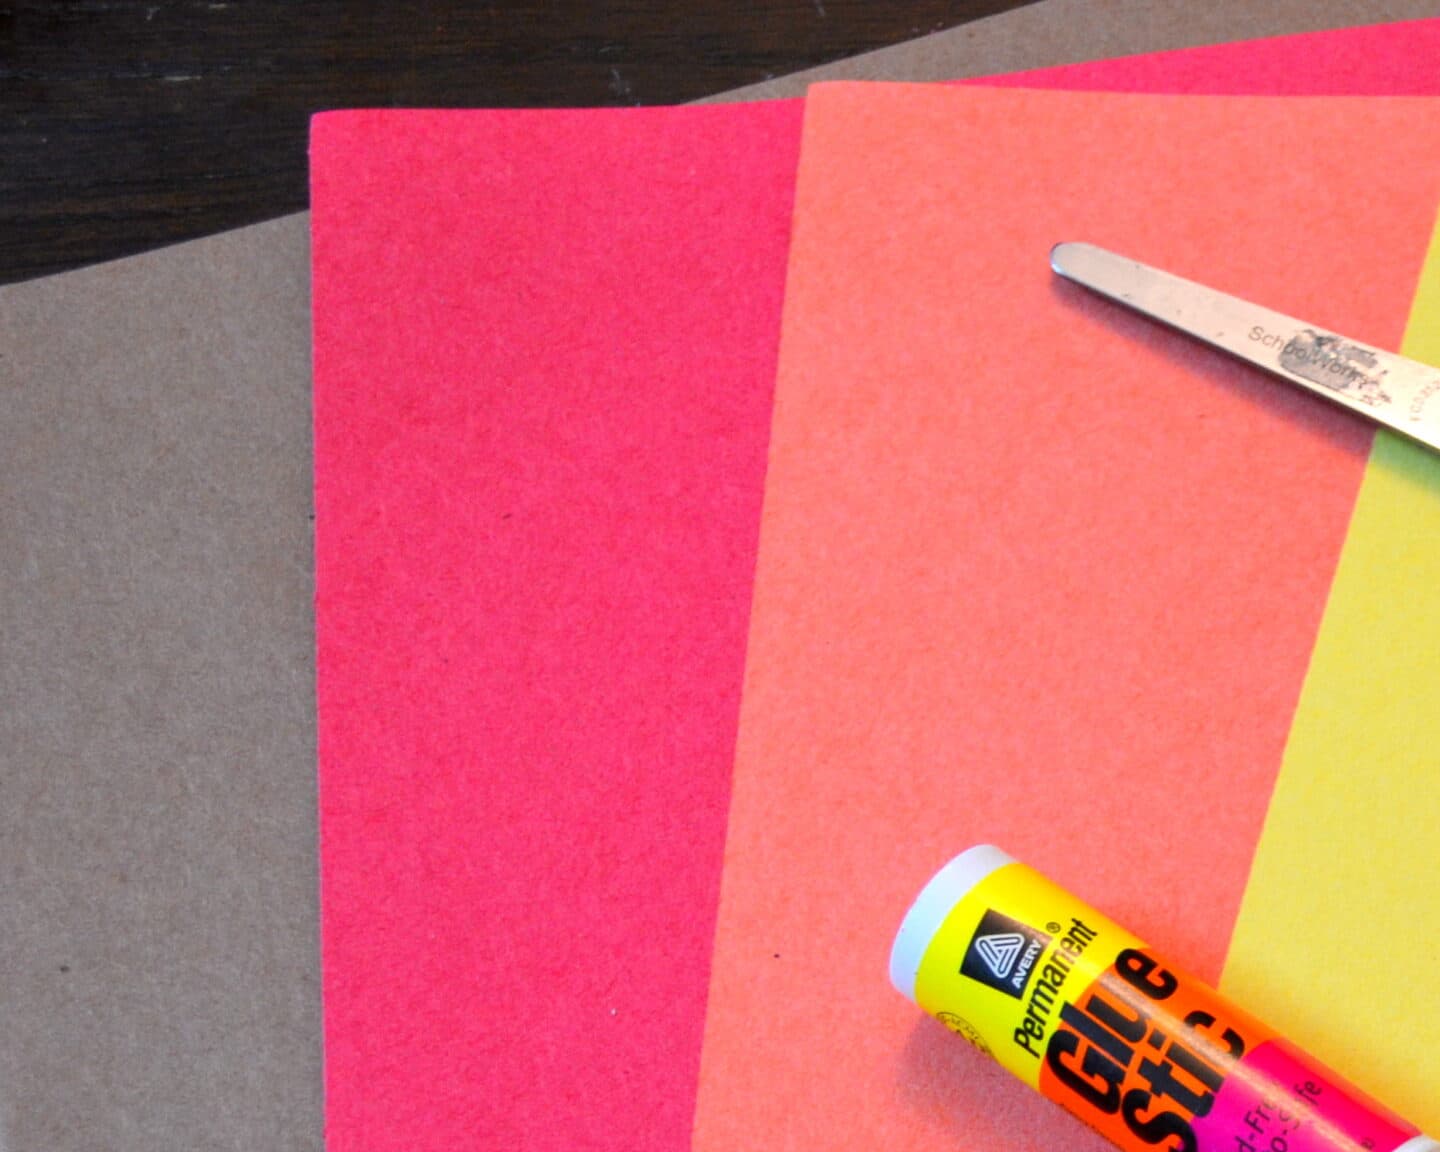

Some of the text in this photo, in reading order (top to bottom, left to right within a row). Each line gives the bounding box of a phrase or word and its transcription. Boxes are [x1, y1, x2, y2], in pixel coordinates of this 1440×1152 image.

[1011, 938, 1043, 990] AVERY
[1013, 918, 1098, 1060] Permanent
[1046, 948, 1179, 1115] Glue
